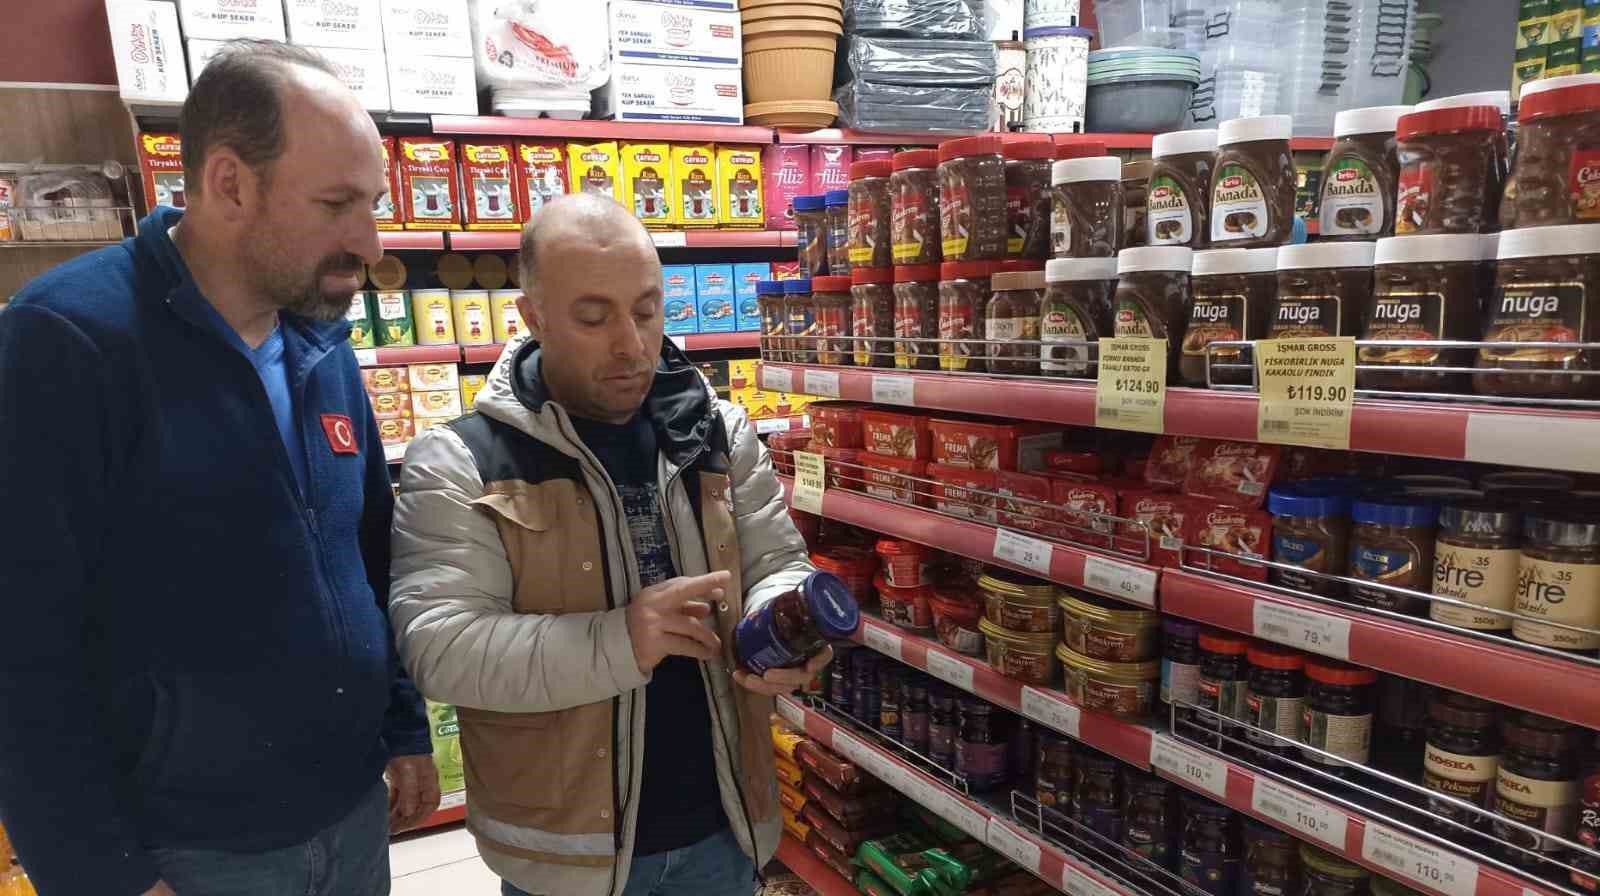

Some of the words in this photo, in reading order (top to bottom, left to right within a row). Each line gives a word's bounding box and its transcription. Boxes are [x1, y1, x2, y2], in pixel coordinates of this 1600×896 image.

[1192, 304, 1228, 322] nuga
[1278, 304, 1320, 323] nuga
[1376, 302, 1422, 323] nuga
[1501, 296, 1559, 317] nuga
[1307, 343, 1337, 352] GROSS
[1320, 358, 1345, 366] NUGA
[1287, 385, 1346, 401] ₺119.90
[1435, 562, 1484, 588] erre
[1517, 577, 1566, 604] erre
